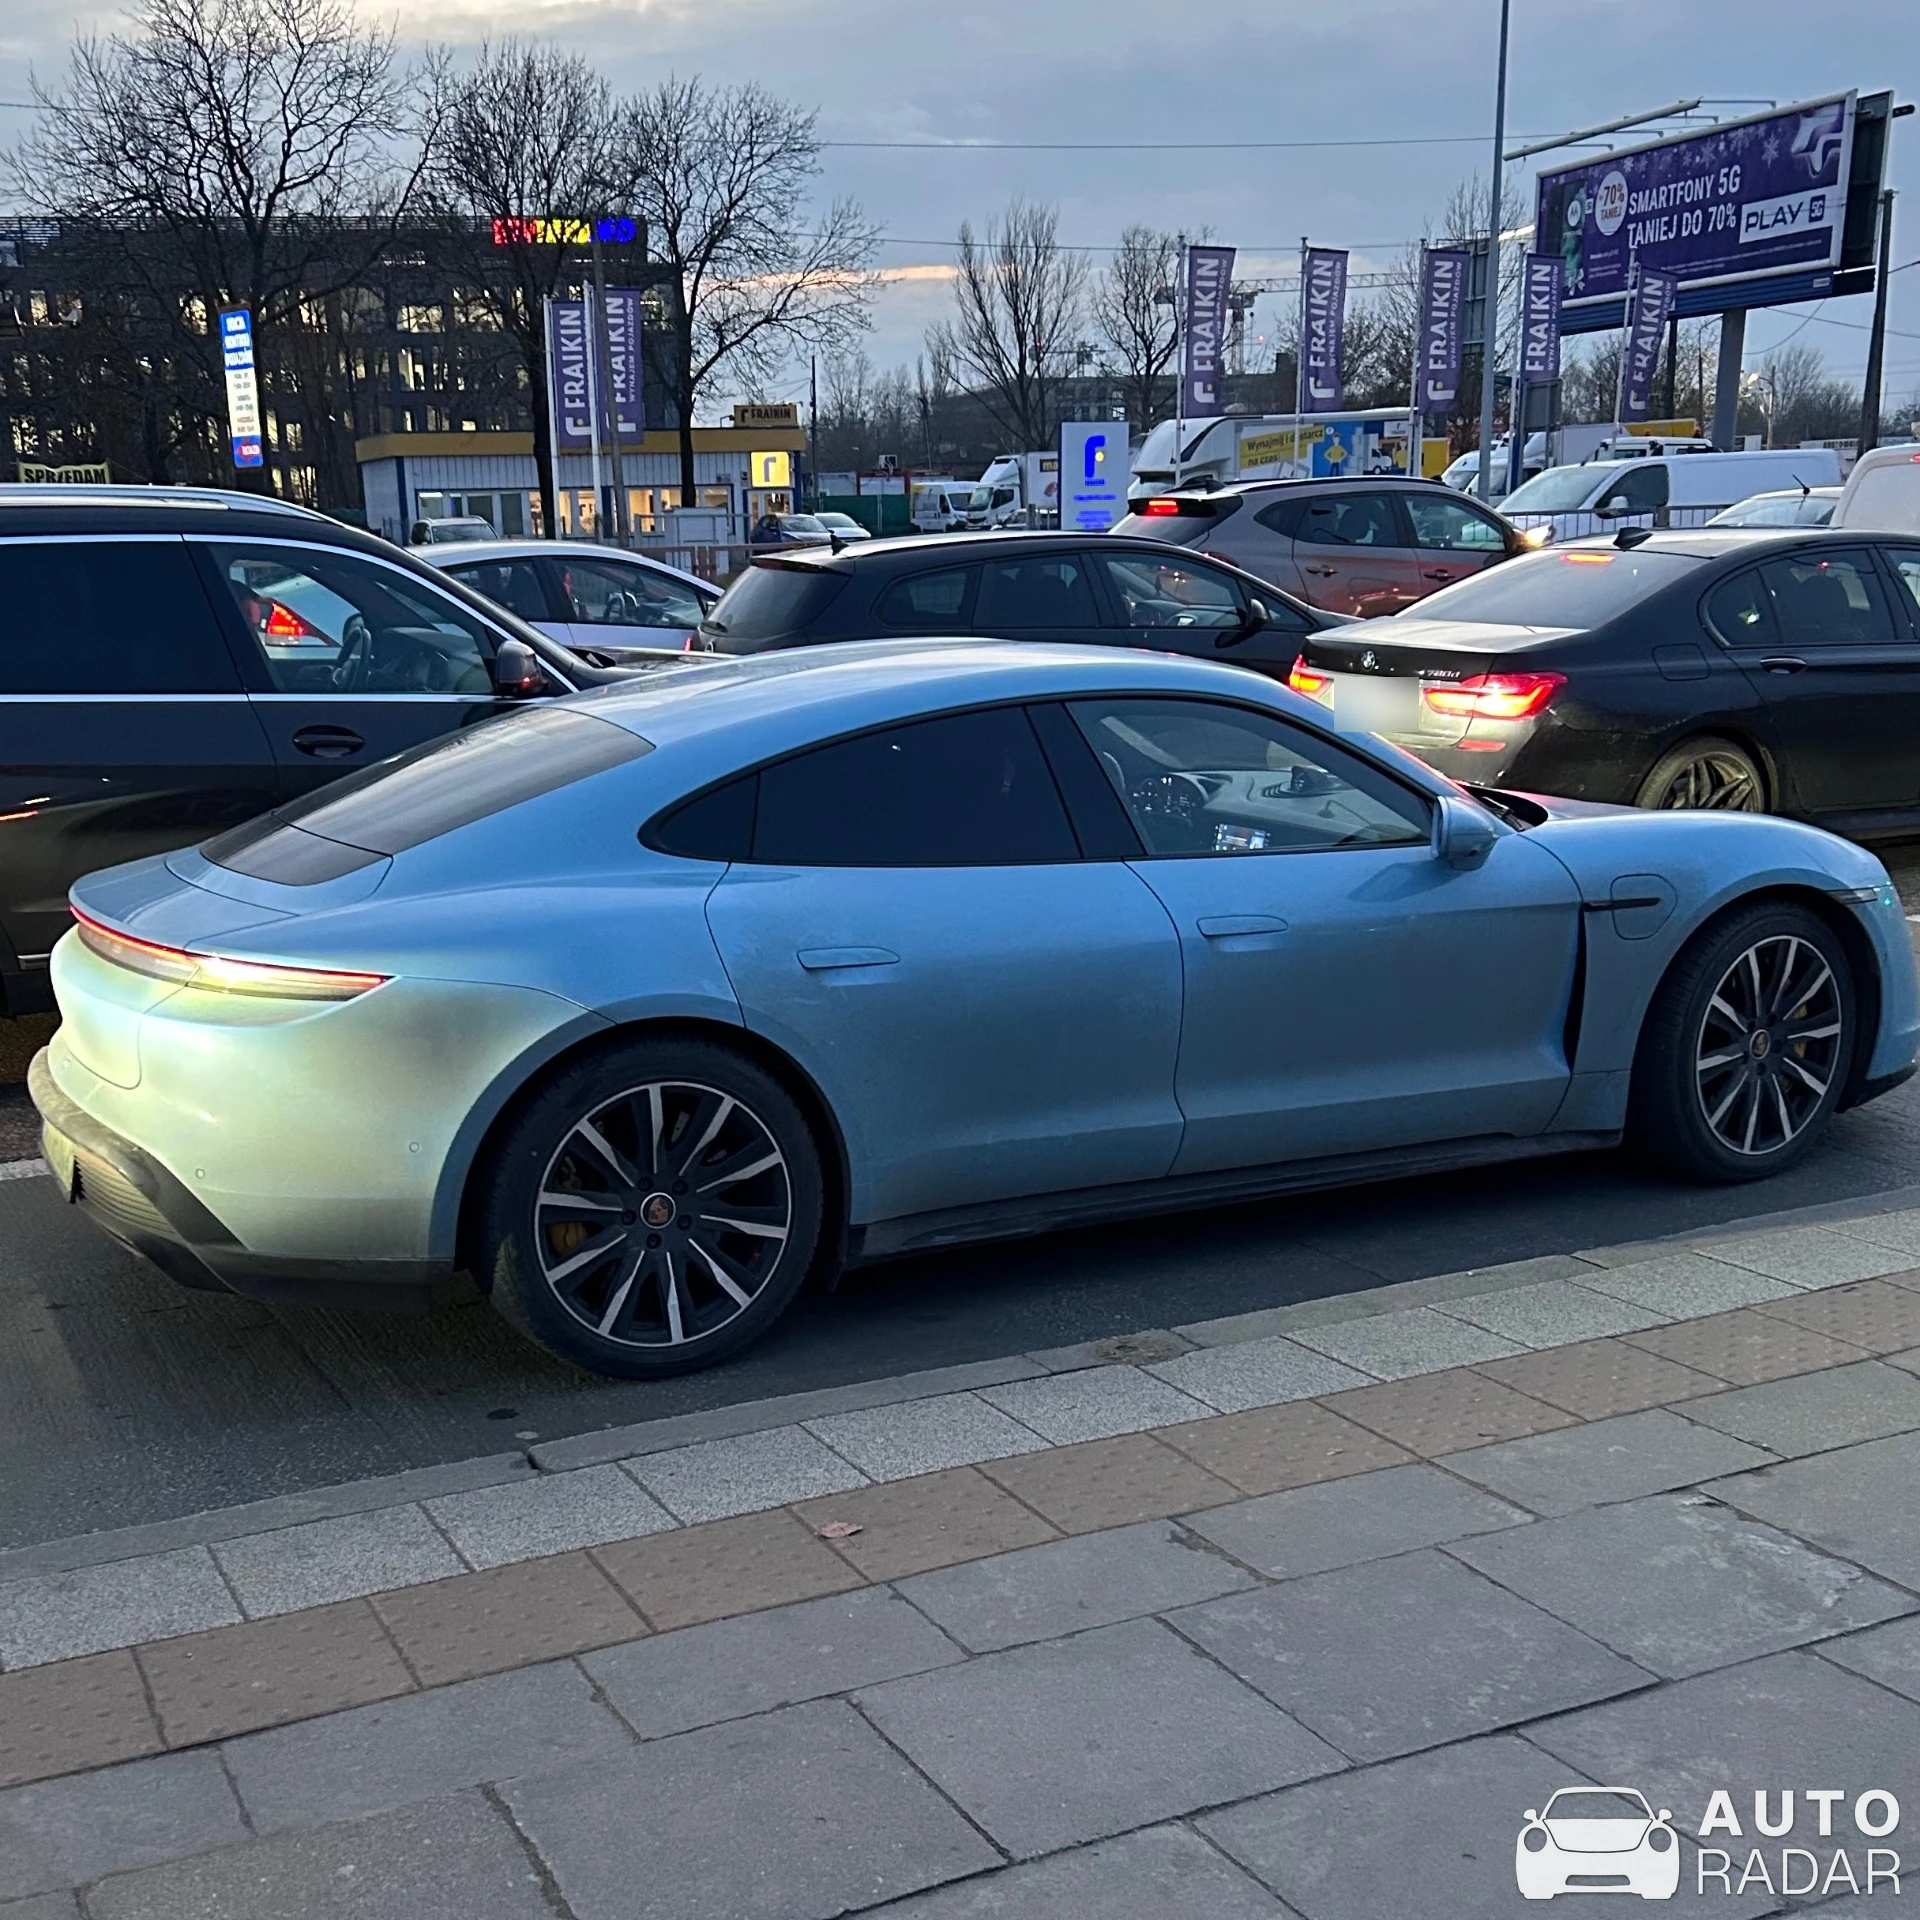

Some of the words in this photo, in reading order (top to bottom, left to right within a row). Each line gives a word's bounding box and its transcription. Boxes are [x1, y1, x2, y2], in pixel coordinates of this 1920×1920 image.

[1628, 174, 1714, 215] SMARTFONY
[1718, 164, 1741, 196] 5G
[1627, 214, 1677, 248] TANIEJ
[1681, 209, 1702, 237] DO
[1708, 202, 1736, 232] 70%
[1745, 201, 1803, 233] PLAY
[1810, 200, 1823, 218] 5G
[1193, 258, 1219, 372] FRAIKIN
[1309, 259, 1334, 367] FRAIKIN
[1428, 260, 1454, 370] FRAIKIN
[1525, 264, 1551, 372] FRAIKIN
[1632, 277, 1664, 383] FRAIKIN
[559, 309, 586, 409] FRAIKIN
[1449, 322, 1457, 369] WYNAJEM
[1547, 324, 1556, 371] WYNAJEM
[751, 407, 791, 419] FRAIKIN
[1247, 432, 1284, 451] Wynajmij
[1290, 427, 1324, 442] dstarcz
[1248, 457, 1259, 466] na
[1260, 454, 1278, 465] czas
